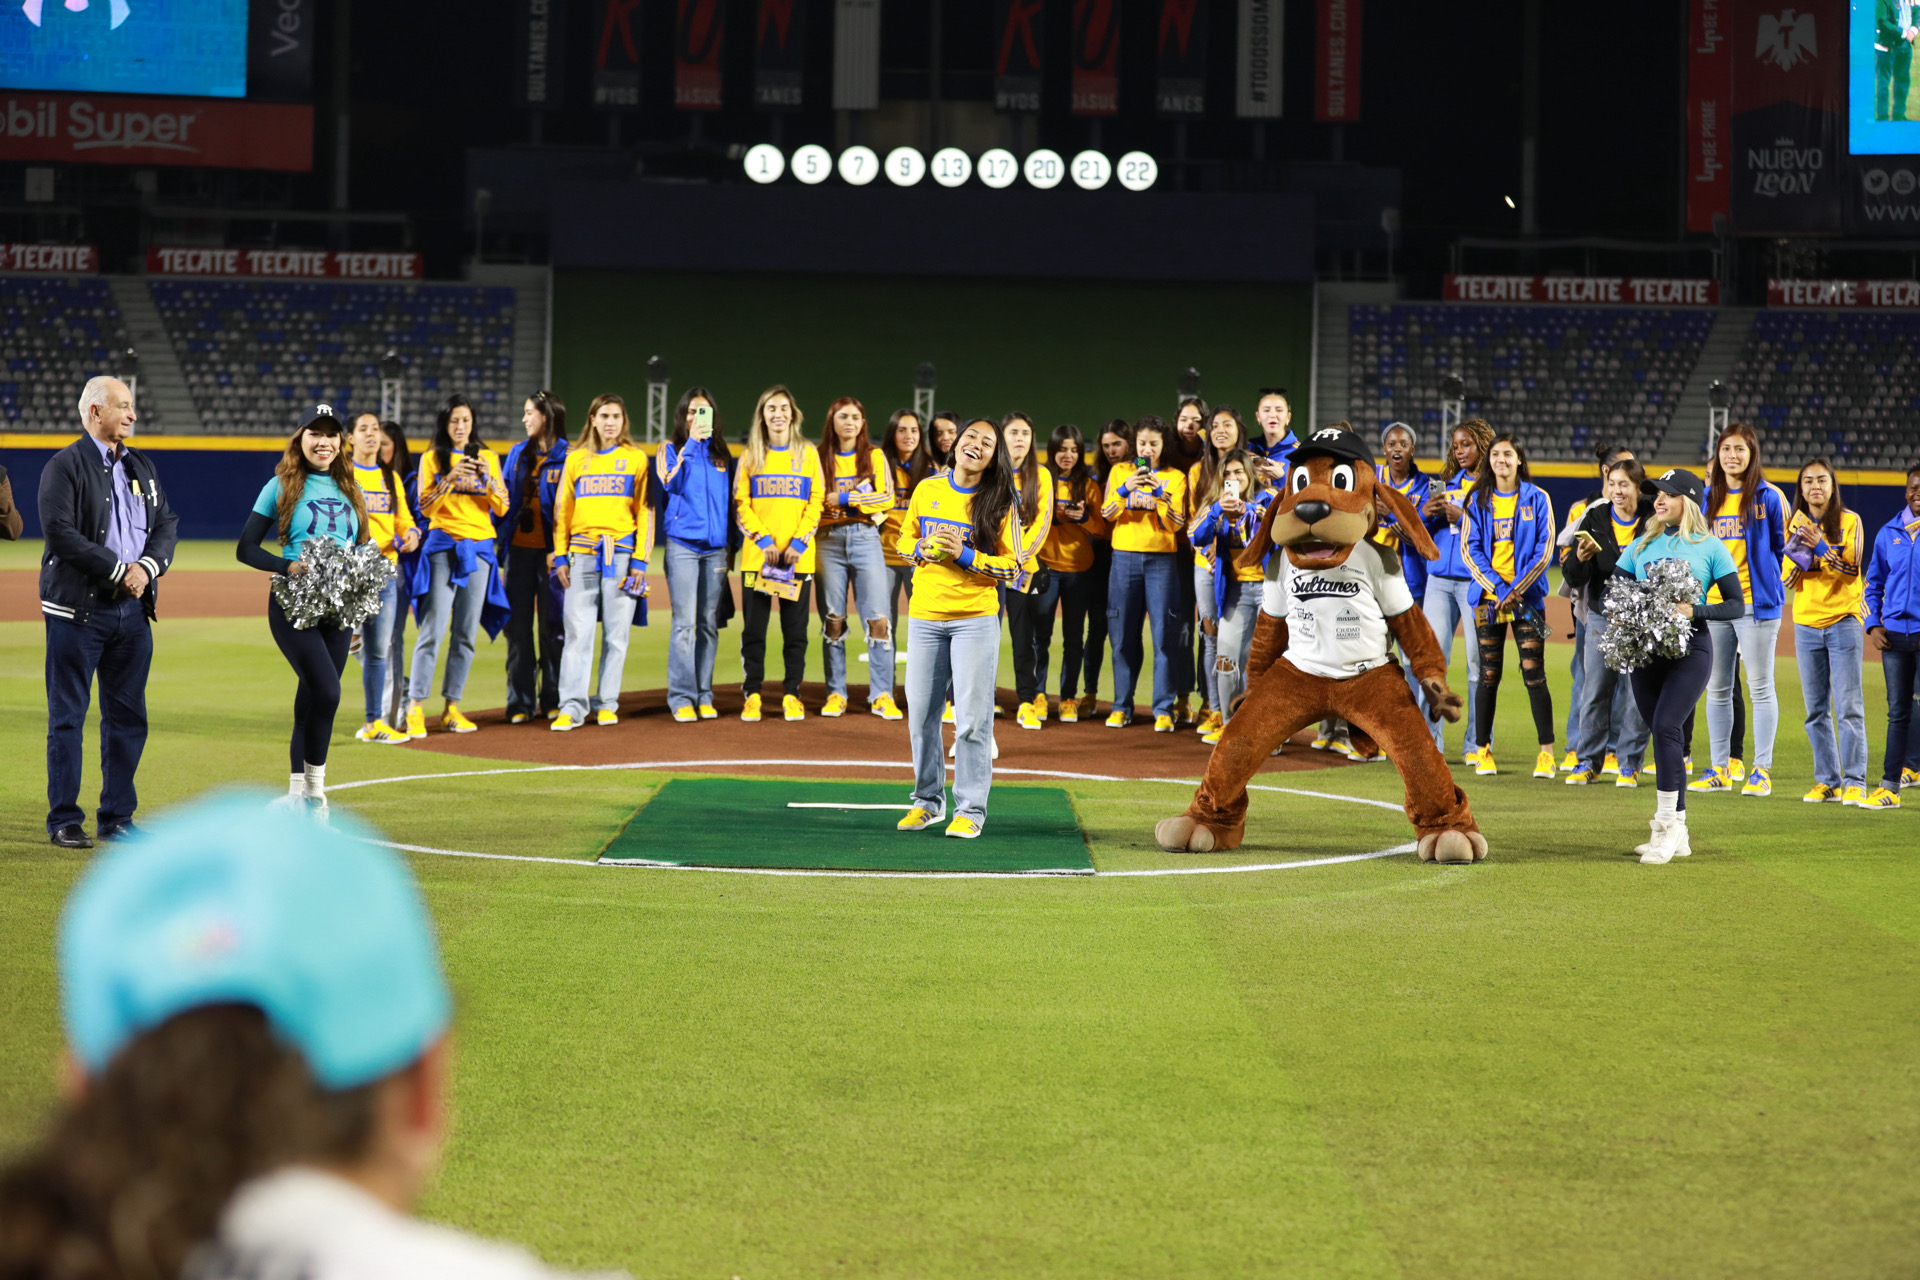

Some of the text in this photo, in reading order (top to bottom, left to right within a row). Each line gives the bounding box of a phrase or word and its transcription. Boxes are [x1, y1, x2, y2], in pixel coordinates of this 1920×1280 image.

[0, 100, 197, 148] bil Super
[1701, 99, 1717, 138] PRIME
[760, 154, 1150, 181] 1 5 7 9 13 17 20 21 22
[10, 245, 91, 270] TECATE
[157, 248, 417, 277] TECATE TECATE TECATE
[1453, 276, 1711, 303] TECATE TECATE TECATE
[1779, 279, 1858, 304] TECATE
[615, 459, 627, 471] U
[580, 476, 625, 494] TIGRES
[756, 477, 802, 496] TIGRES
[1520, 506, 1534, 521] U
[1291, 576, 1360, 594] Sultanes
